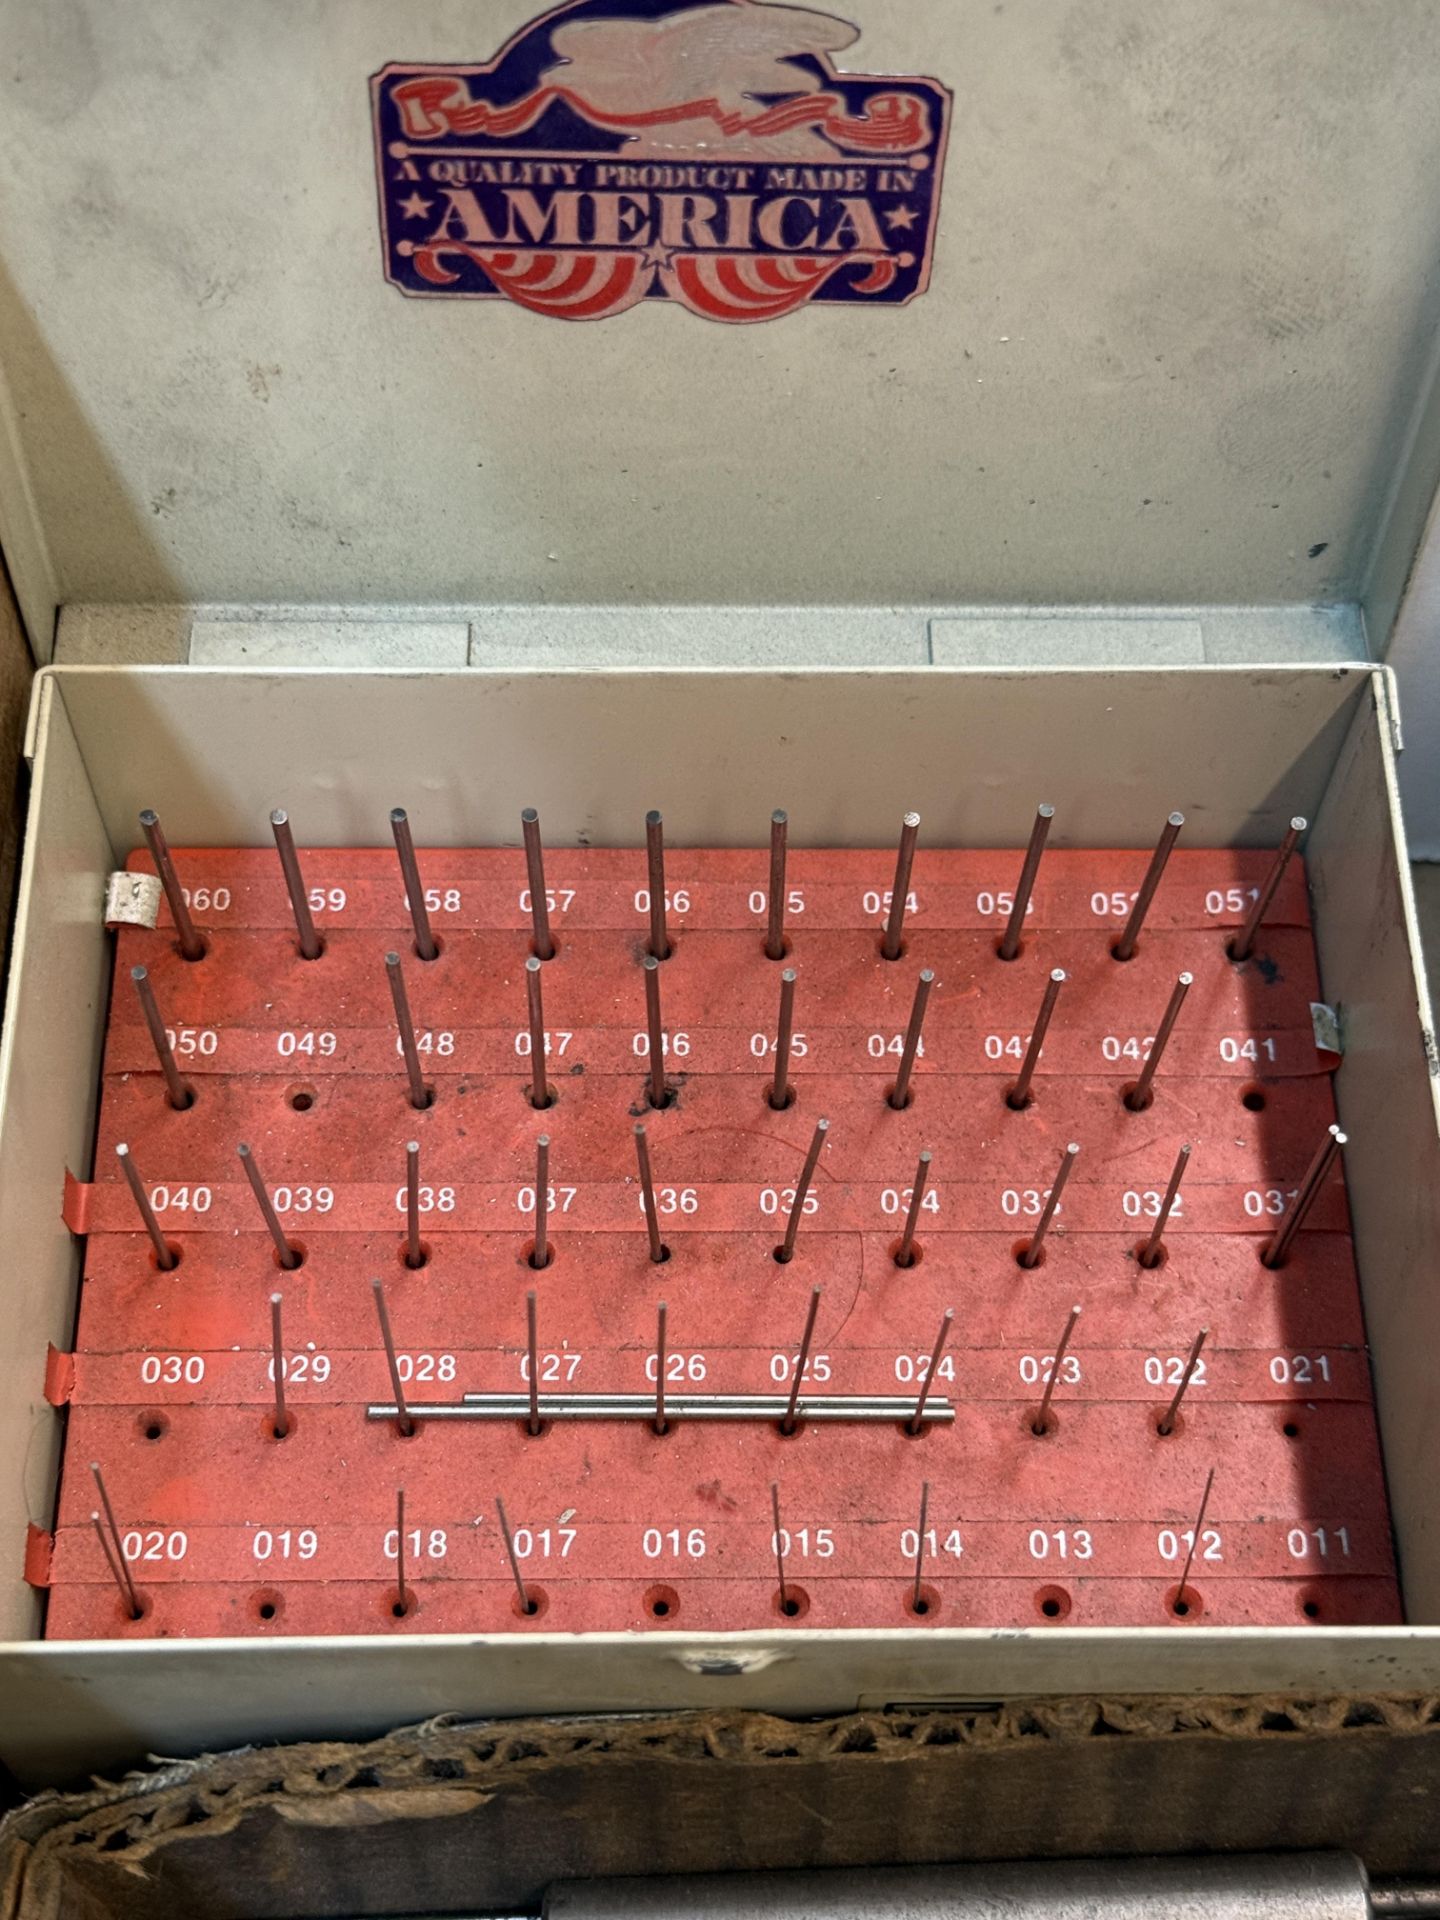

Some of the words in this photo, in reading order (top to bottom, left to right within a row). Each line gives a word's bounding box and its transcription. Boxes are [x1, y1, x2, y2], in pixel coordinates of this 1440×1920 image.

[394, 160, 421, 183] A
[428, 162, 582, 187] QUALITY
[594, 165, 756, 191] PRODUCT
[764, 168, 867, 193] MADE
[877, 170, 917, 193] IN
[431, 190, 890, 252] AMERICA
[290, 888, 347, 912] 59
[404, 889, 461, 912] 58
[749, 890, 806, 914] 05
[1091, 891, 1142, 916] 05
[277, 1031, 337, 1056] 049
[396, 1031, 455, 1056] 48
[984, 1034, 1043, 1059] 04
[1102, 1036, 1157, 1061] 042
[1219, 1037, 1277, 1062] 041
[149, 1186, 212, 1212] 040
[273, 1186, 334, 1212] 039
[395, 1187, 456, 1213] 038
[759, 1188, 819, 1214] 035
[880, 1188, 940, 1214] 034
[1122, 1190, 1183, 1216] 032
[141, 1355, 206, 1384] 030
[267, 1354, 332, 1383] 029
[397, 1354, 456, 1382] 028
[520, 1354, 583, 1382] 027
[645, 1354, 707, 1382] 026
[769, 1354, 832, 1382] 025
[894, 1354, 955, 1382] 024
[1019, 1355, 1081, 1383] 023
[1144, 1356, 1207, 1385] 022
[1269, 1355, 1331, 1385] 021
[122, 1530, 188, 1560] 020
[253, 1530, 318, 1559] 019
[384, 1529, 448, 1558] 018
[513, 1529, 577, 1558] 017
[643, 1529, 706, 1557] 016
[771, 1529, 835, 1557] 015
[900, 1529, 963, 1558] 014
[1029, 1529, 1093, 1559] 013
[1158, 1530, 1223, 1560] 012
[1287, 1528, 1350, 1557] 011
